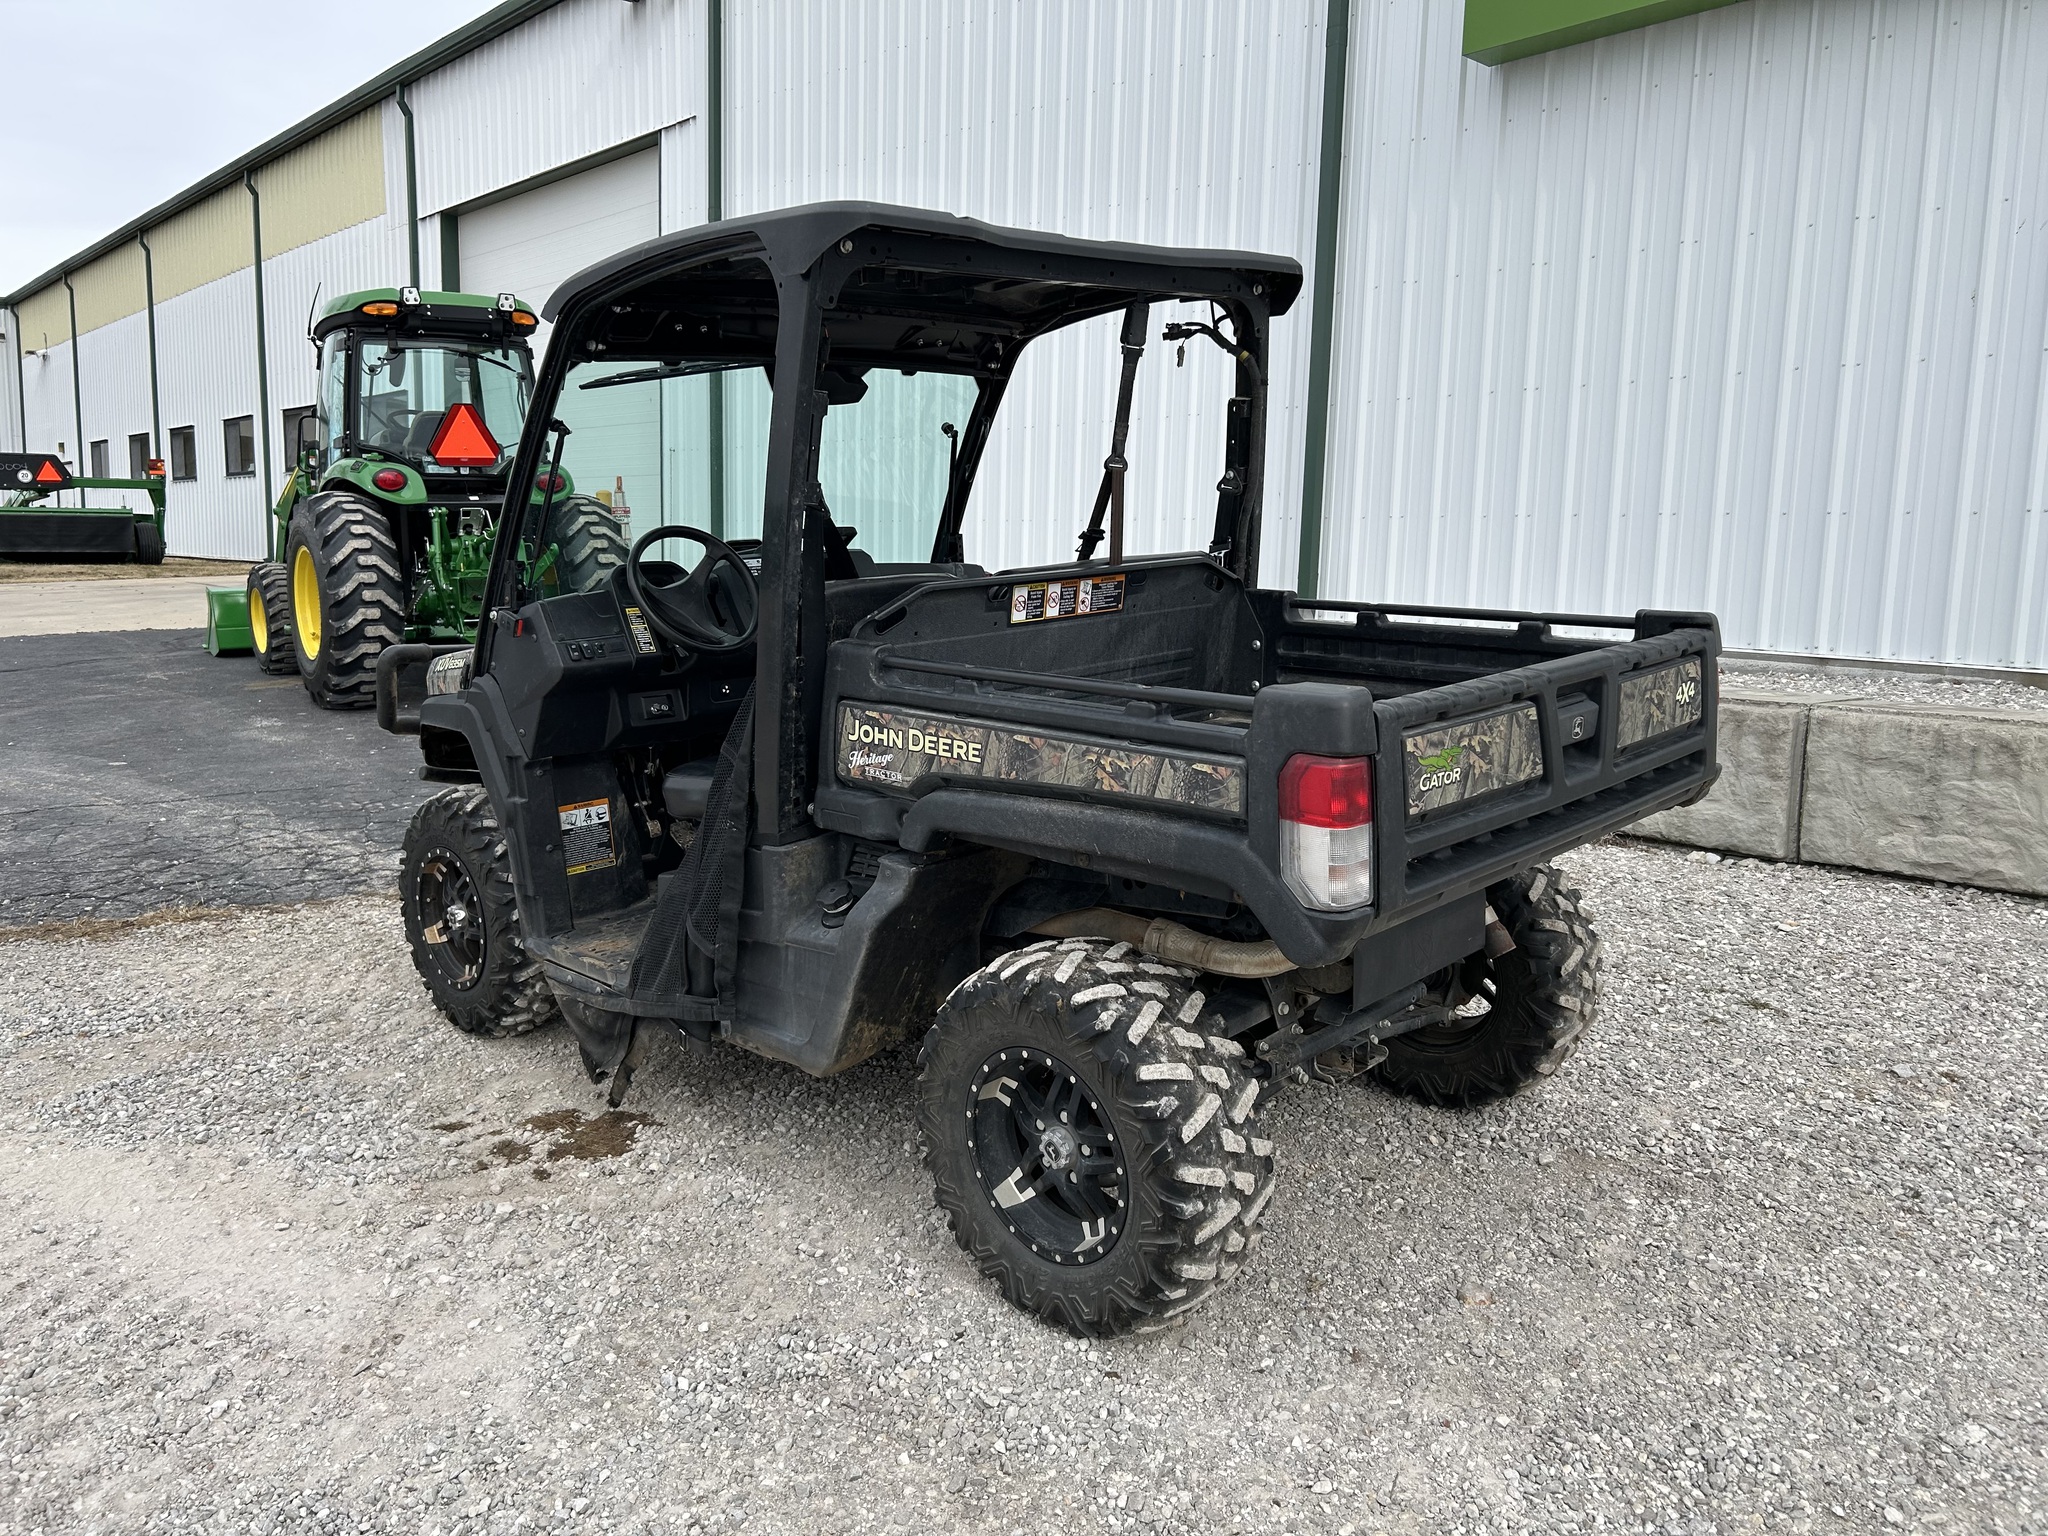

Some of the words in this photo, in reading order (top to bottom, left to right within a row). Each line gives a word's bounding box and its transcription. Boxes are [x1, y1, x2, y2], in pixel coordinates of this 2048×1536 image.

[848, 719, 903, 749] JOHN
[908, 728, 982, 763] DEERE
[848, 750, 894, 768] Heritage
[865, 767, 903, 782] TRACTOR
[1419, 767, 1461, 791] GATOR
